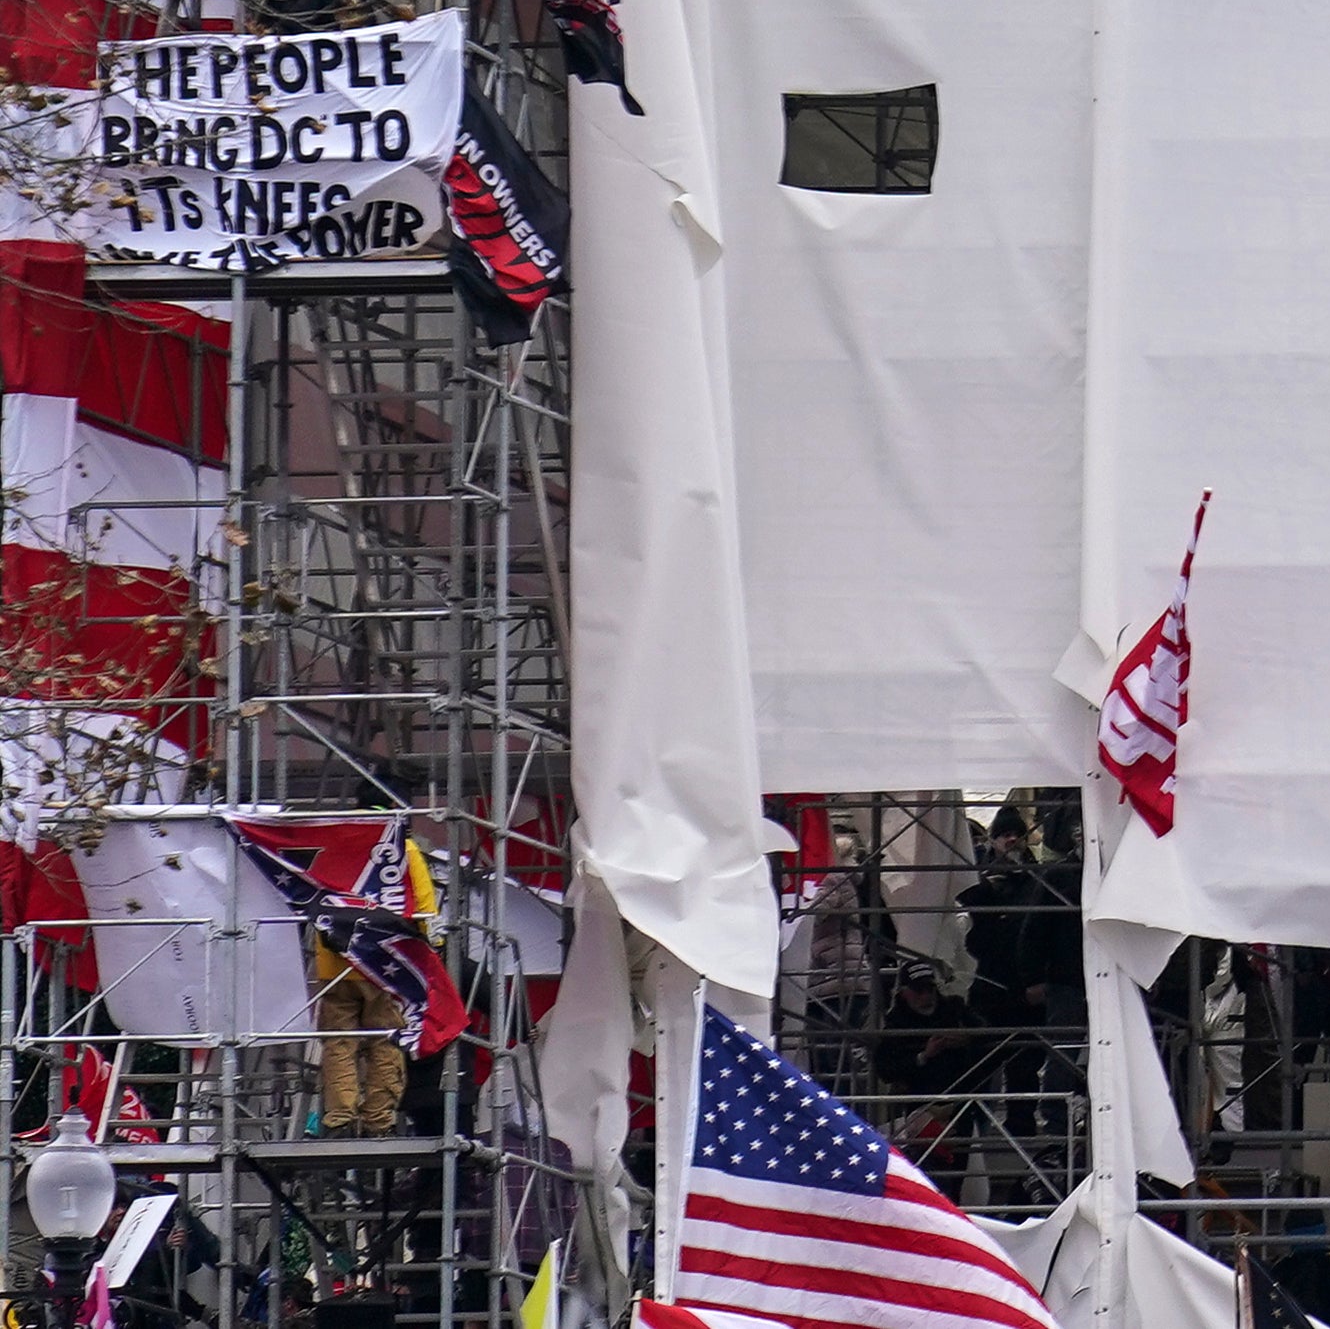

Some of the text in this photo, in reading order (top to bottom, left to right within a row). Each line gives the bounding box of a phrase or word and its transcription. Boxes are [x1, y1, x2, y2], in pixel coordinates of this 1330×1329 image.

[210, 33, 405, 99] PEOPLE
[252, 115, 325, 170] DC
[336, 109, 410, 162] TO
[478, 163, 556, 268] OWNERS
